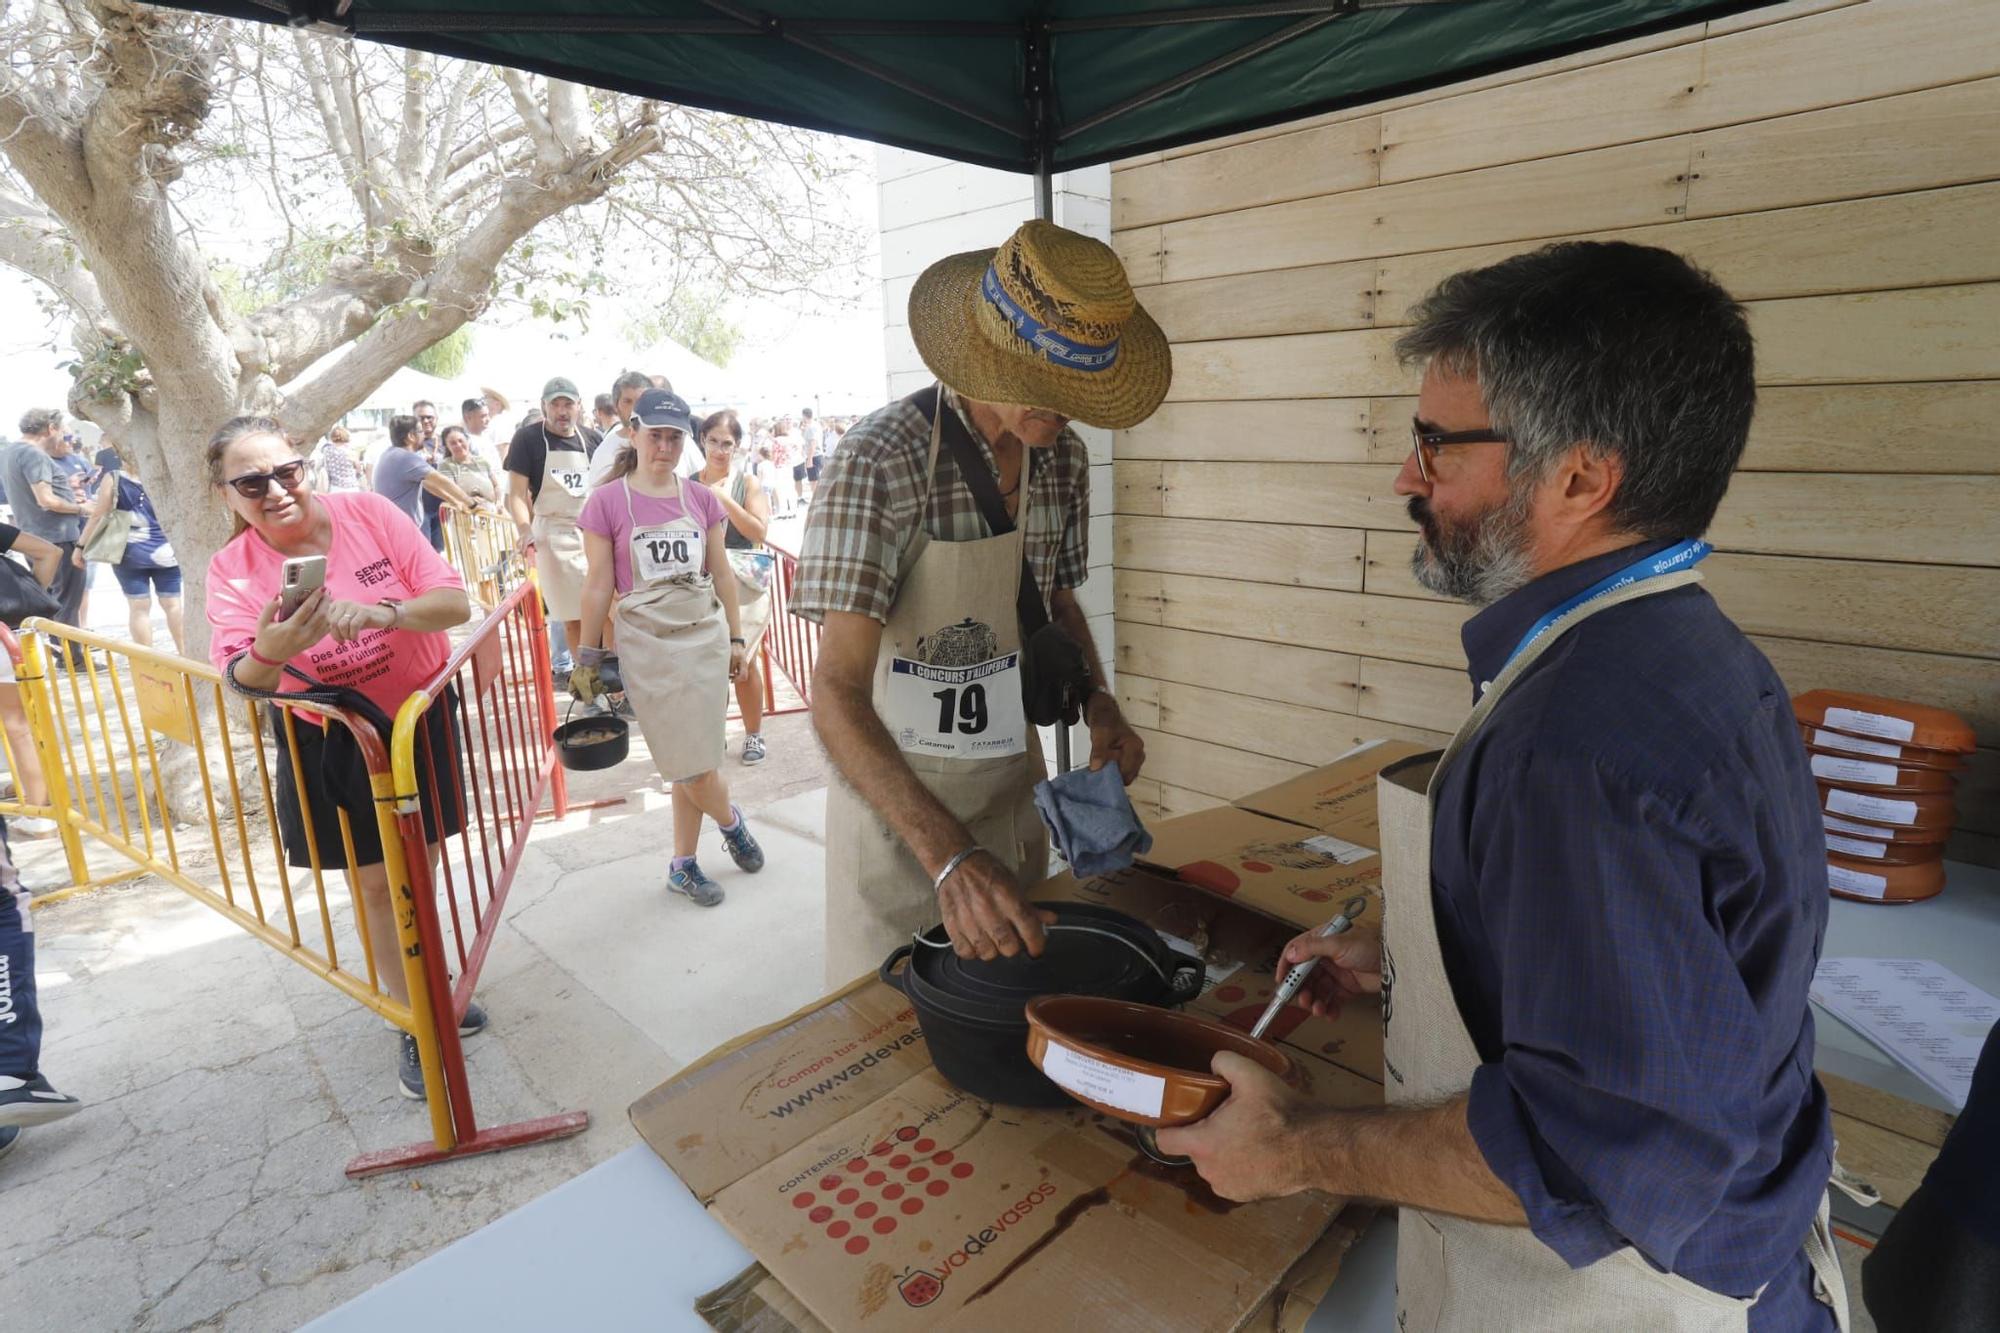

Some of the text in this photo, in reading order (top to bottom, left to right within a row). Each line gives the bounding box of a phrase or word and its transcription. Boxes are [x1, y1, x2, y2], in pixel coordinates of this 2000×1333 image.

[564, 473, 583, 489] 82
[646, 540, 689, 564] 120
[1653, 547, 1693, 573] Catarroja
[355, 558, 392, 580] SEMPR
[359, 570, 392, 588] TEUA
[311, 626, 399, 664] Des de la primer
[316, 662, 338, 675] fins
[341, 658, 348, 668] a
[321, 651, 395, 685] sempre estaré
[917, 666, 965, 683] CONCURS
[966, 657, 1009, 681] D'ALLIPEBRE
[933, 683, 988, 735] 19
[919, 738, 955, 750] Catarroja
[770, 1027, 924, 1119] www.vadevas
[777, 1056, 834, 1089] Compra
[834, 1041, 857, 1057] tus
[779, 1145, 852, 1193] CONTENIDO:
[934, 1182, 1056, 1279] vadevasos
